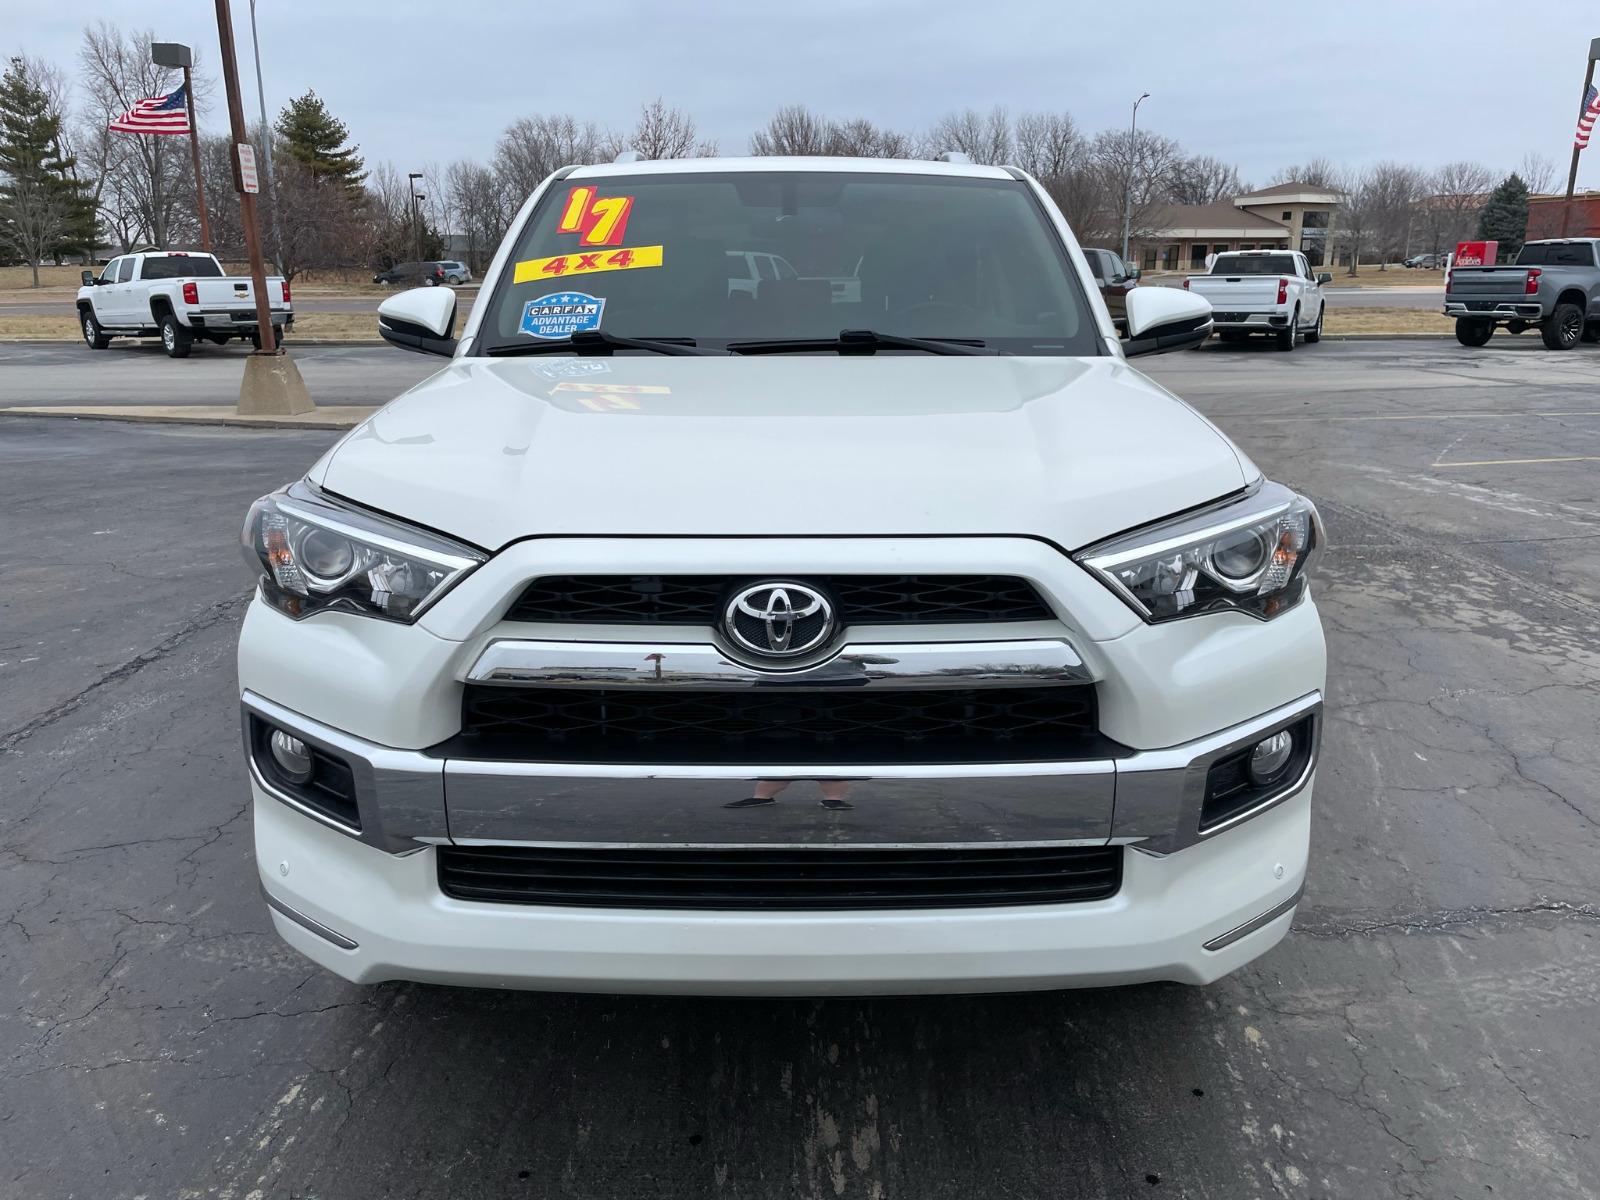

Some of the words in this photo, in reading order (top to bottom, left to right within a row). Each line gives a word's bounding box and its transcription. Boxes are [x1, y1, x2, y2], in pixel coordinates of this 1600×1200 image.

[560, 187, 630, 245] 17
[529, 304, 597, 316] CARFAX
[531, 315, 590, 326] ADVANTAGE
[539, 324, 578, 334] DEALER
